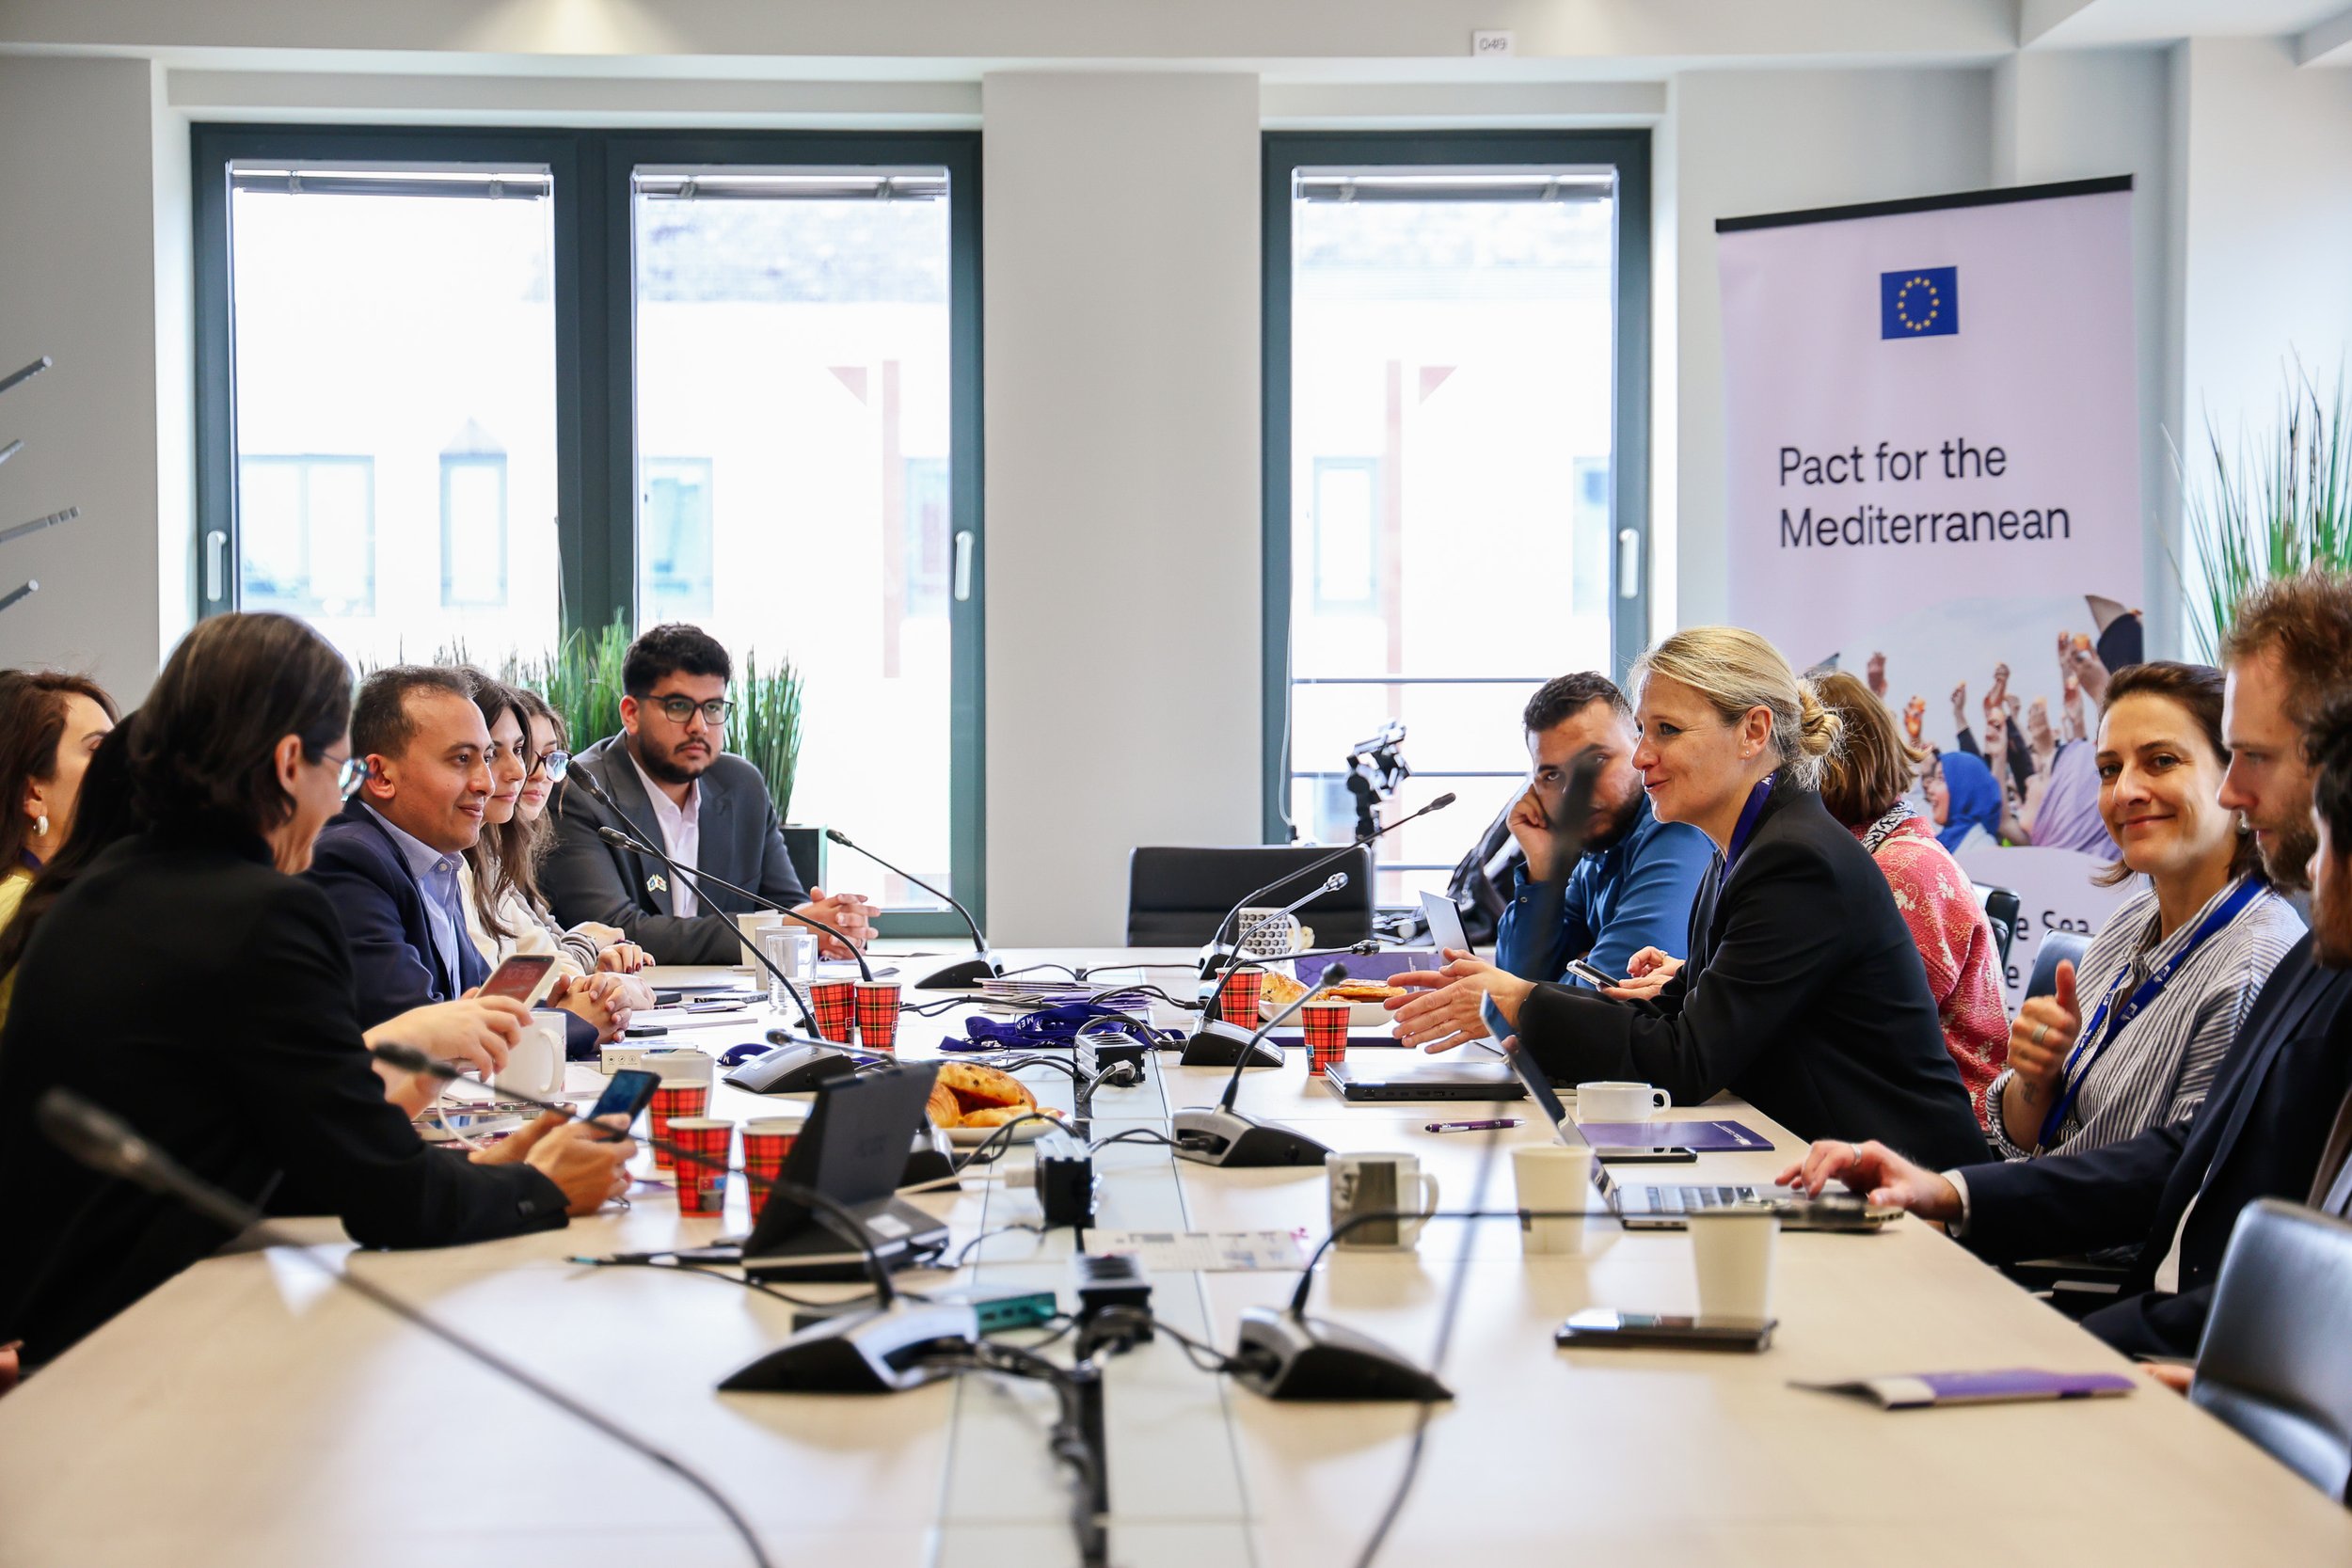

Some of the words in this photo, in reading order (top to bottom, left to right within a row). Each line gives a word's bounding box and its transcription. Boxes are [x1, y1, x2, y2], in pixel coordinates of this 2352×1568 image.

[1779, 445, 1865, 486] Pact
[1875, 441, 1929, 482] for
[1940, 436, 2007, 480] the
[1780, 504, 2071, 548] Mediterranean
